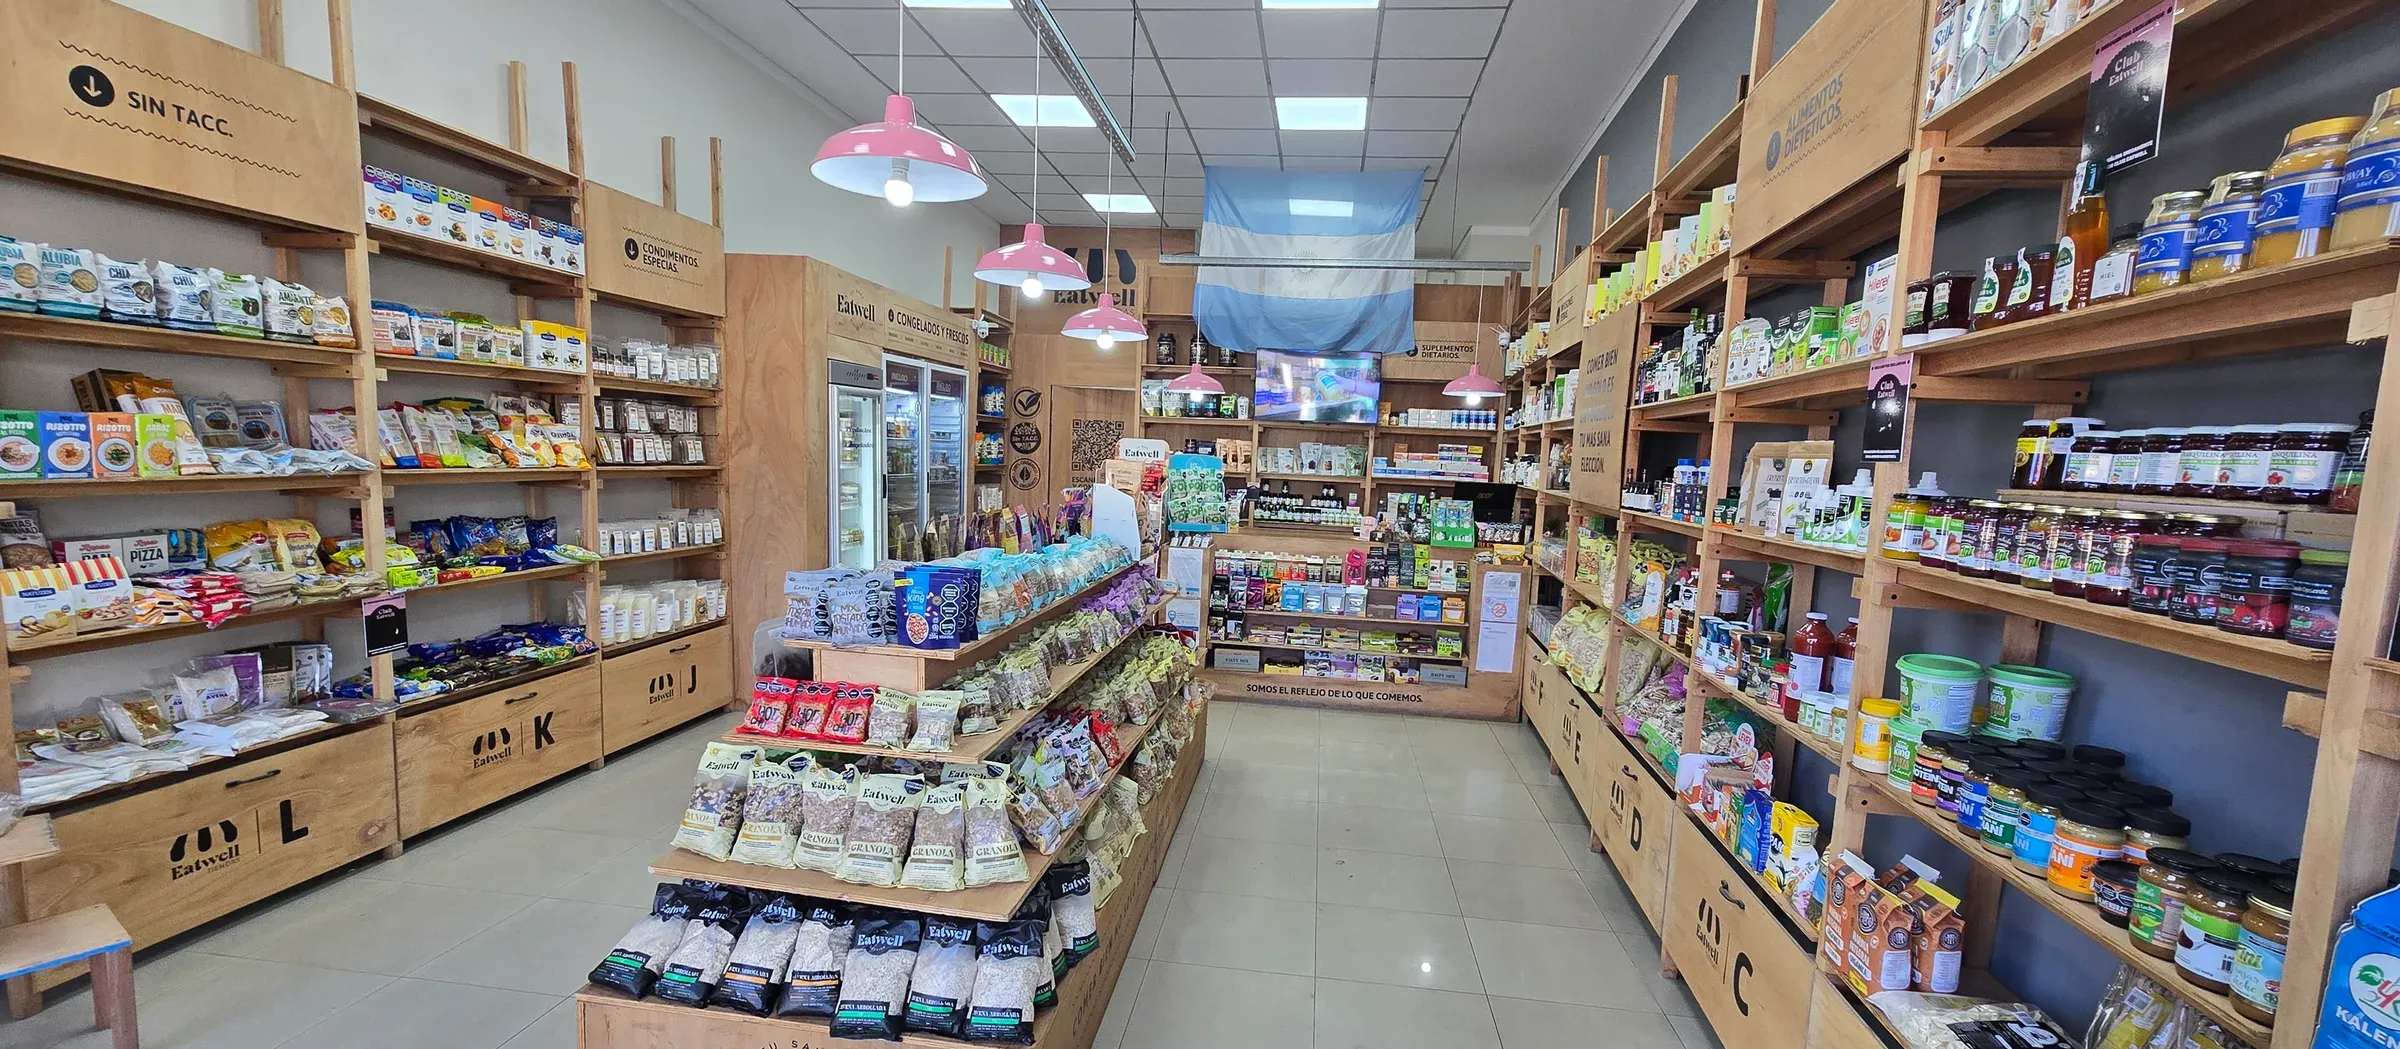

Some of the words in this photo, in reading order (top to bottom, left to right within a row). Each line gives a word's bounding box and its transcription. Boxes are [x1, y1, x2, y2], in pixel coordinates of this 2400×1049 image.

[1931, 20, 1955, 55] Silk
[2114, 50, 2141, 73] Club
[2108, 60, 2143, 87] Eatwell
[1786, 72, 1844, 137] ALIMENTOS
[127, 90, 166, 118] SIN
[171, 102, 234, 138] TACC.
[41, 251, 83, 267] ALUBIA
[642, 242, 700, 268] CONDIMENTOS.
[643, 255, 679, 274] ESPECIAS.
[2100, 271, 2116, 280] MIEL
[837, 293, 875, 322] Eatwell
[896, 311, 940, 337] CONGELADOS
[940, 325, 946, 337] Y
[945, 327, 969, 345] FRESCOS
[1422, 344, 1474, 353] SUPLEMENTOS
[1587, 355, 1605, 374] COMER
[1605, 348, 1618, 368] BIEN
[1880, 381, 1894, 391] Club
[46, 423, 87, 431] RISOTTO
[96, 424, 132, 432] RISOTTO
[1579, 432, 1587, 448] TU
[1125, 449, 1159, 459] Eatwell
[130, 548, 164, 563] PIZZA
[21, 590, 55, 598] NATUZEN
[907, 592, 925, 603] king
[378, 607, 392, 615] Club
[687, 664, 697, 694] J
[205, 692, 229, 700] AVENA
[649, 688, 675, 705] Eatwell
[1246, 684, 1277, 694] SOMOS
[1279, 686, 1289, 695] EL
[1291, 687, 1326, 697] REFLEJO
[1328, 689, 1340, 698] DE
[1341, 690, 1353, 699] LO
[1355, 691, 1374, 700] QUE
[1376, 692, 1424, 703] COMEMOS.
[1539, 680, 1544, 706] F
[876, 699, 899, 710] Eatwell
[757, 706, 781, 722] HOT
[839, 712, 863, 726] HOT
[534, 711, 556, 750] K
[1738, 734, 1752, 745] LEVEX
[1574, 730, 1582, 766] E
[1894, 746, 1910, 760] king
[473, 746, 512, 770] Eatwell
[705, 760, 739, 771] Eatwell
[752, 769, 796, 780] Eatwell
[862, 788, 906, 805] Eatwell
[280, 799, 309, 844] L
[1630, 806, 1642, 852] D
[802, 831, 840, 845] GRANOLA
[851, 843, 895, 856] GRANOLA
[913, 845, 954, 858] GRANOLA
[975, 842, 1019, 856] GRANOLA
[171, 844, 240, 880] Eatwell
[857, 934, 904, 947] Eatwell
[929, 926, 971, 941] Eatwell
[983, 944, 1028, 956] Eatwell
[1696, 923, 1719, 965] Eatwell
[1733, 952, 1753, 1017] C
